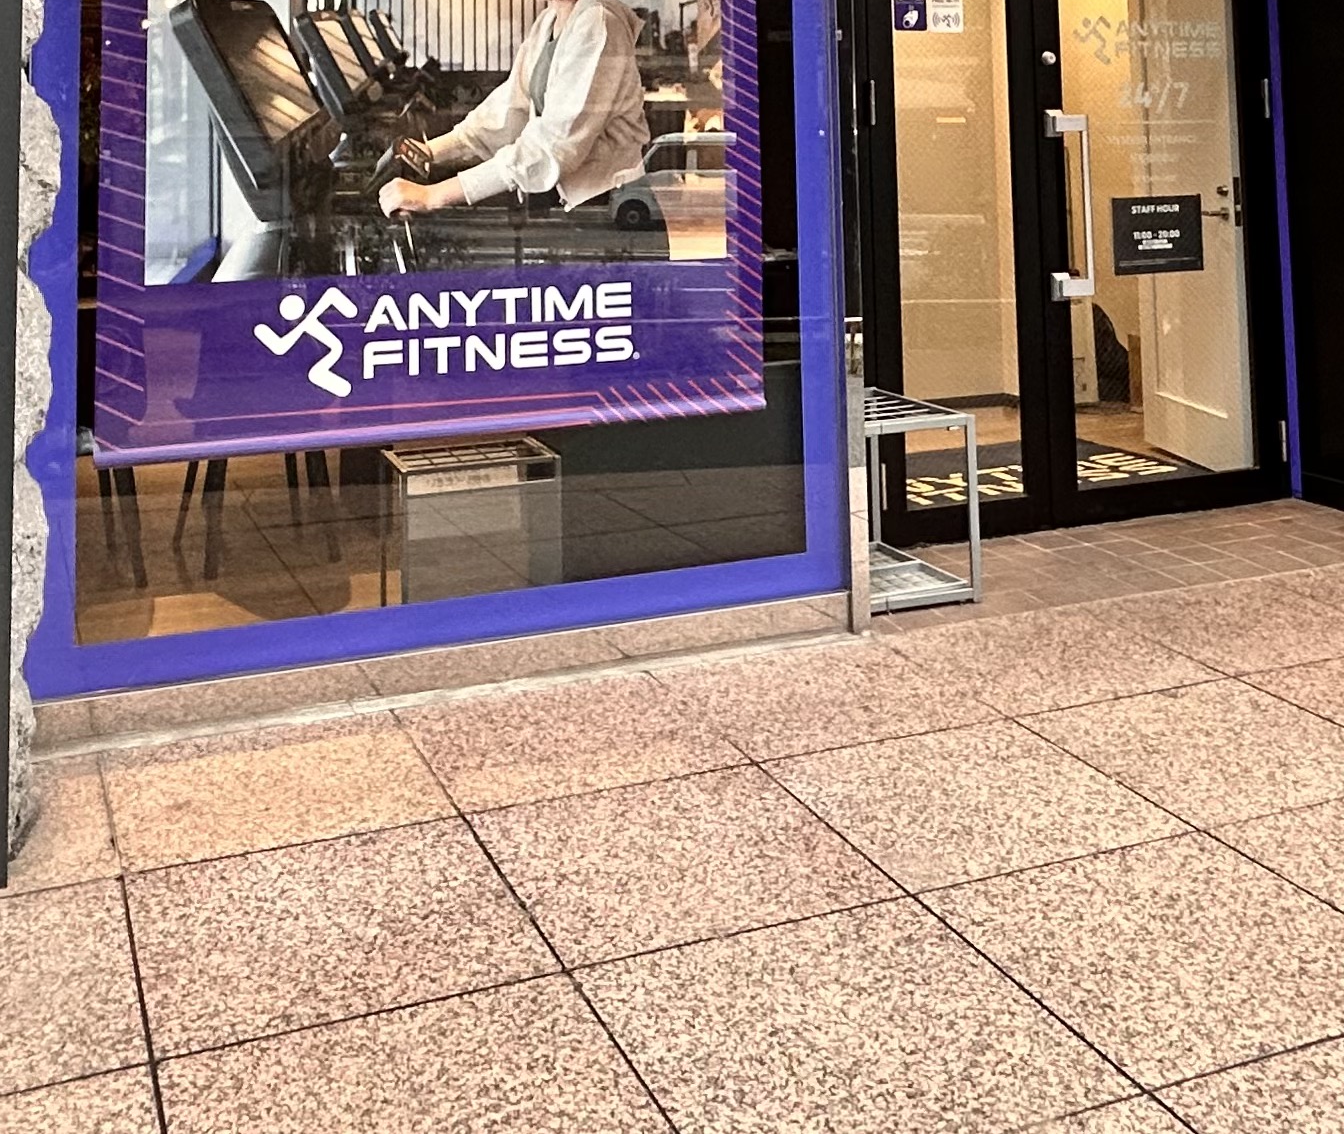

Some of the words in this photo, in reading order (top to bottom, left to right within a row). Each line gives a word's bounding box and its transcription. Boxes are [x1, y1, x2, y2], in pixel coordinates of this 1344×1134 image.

[1115, 20, 1220, 38] ANYTIME
[1115, 41, 1221, 59] FITNESS
[1131, 205, 1155, 214] STAFF
[1156, 204, 1179, 213] HOUR
[363, 281, 632, 334] ANYTIME
